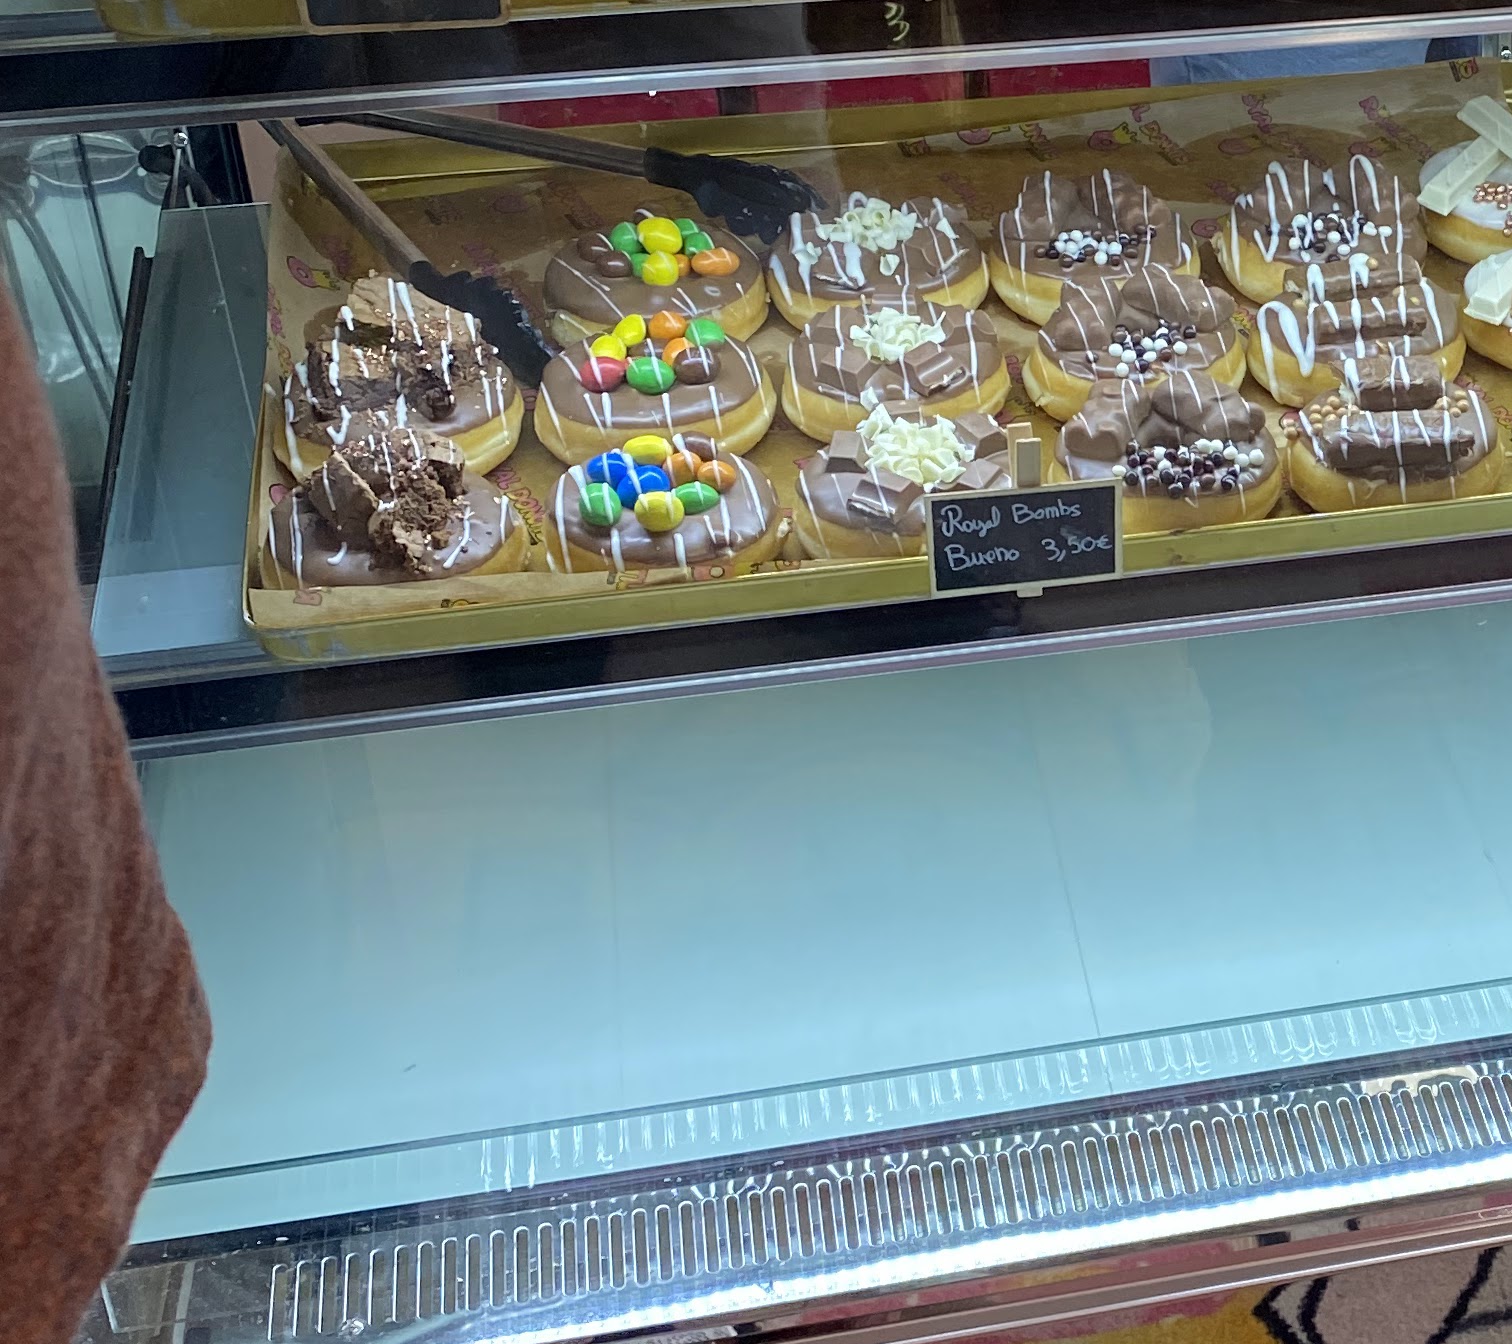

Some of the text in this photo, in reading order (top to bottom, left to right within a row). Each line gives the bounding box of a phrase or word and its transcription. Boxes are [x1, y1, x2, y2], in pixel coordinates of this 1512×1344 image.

[941, 498, 1082, 538] Royal Bombs
[943, 534, 1113, 572] Bueno 3,50€
